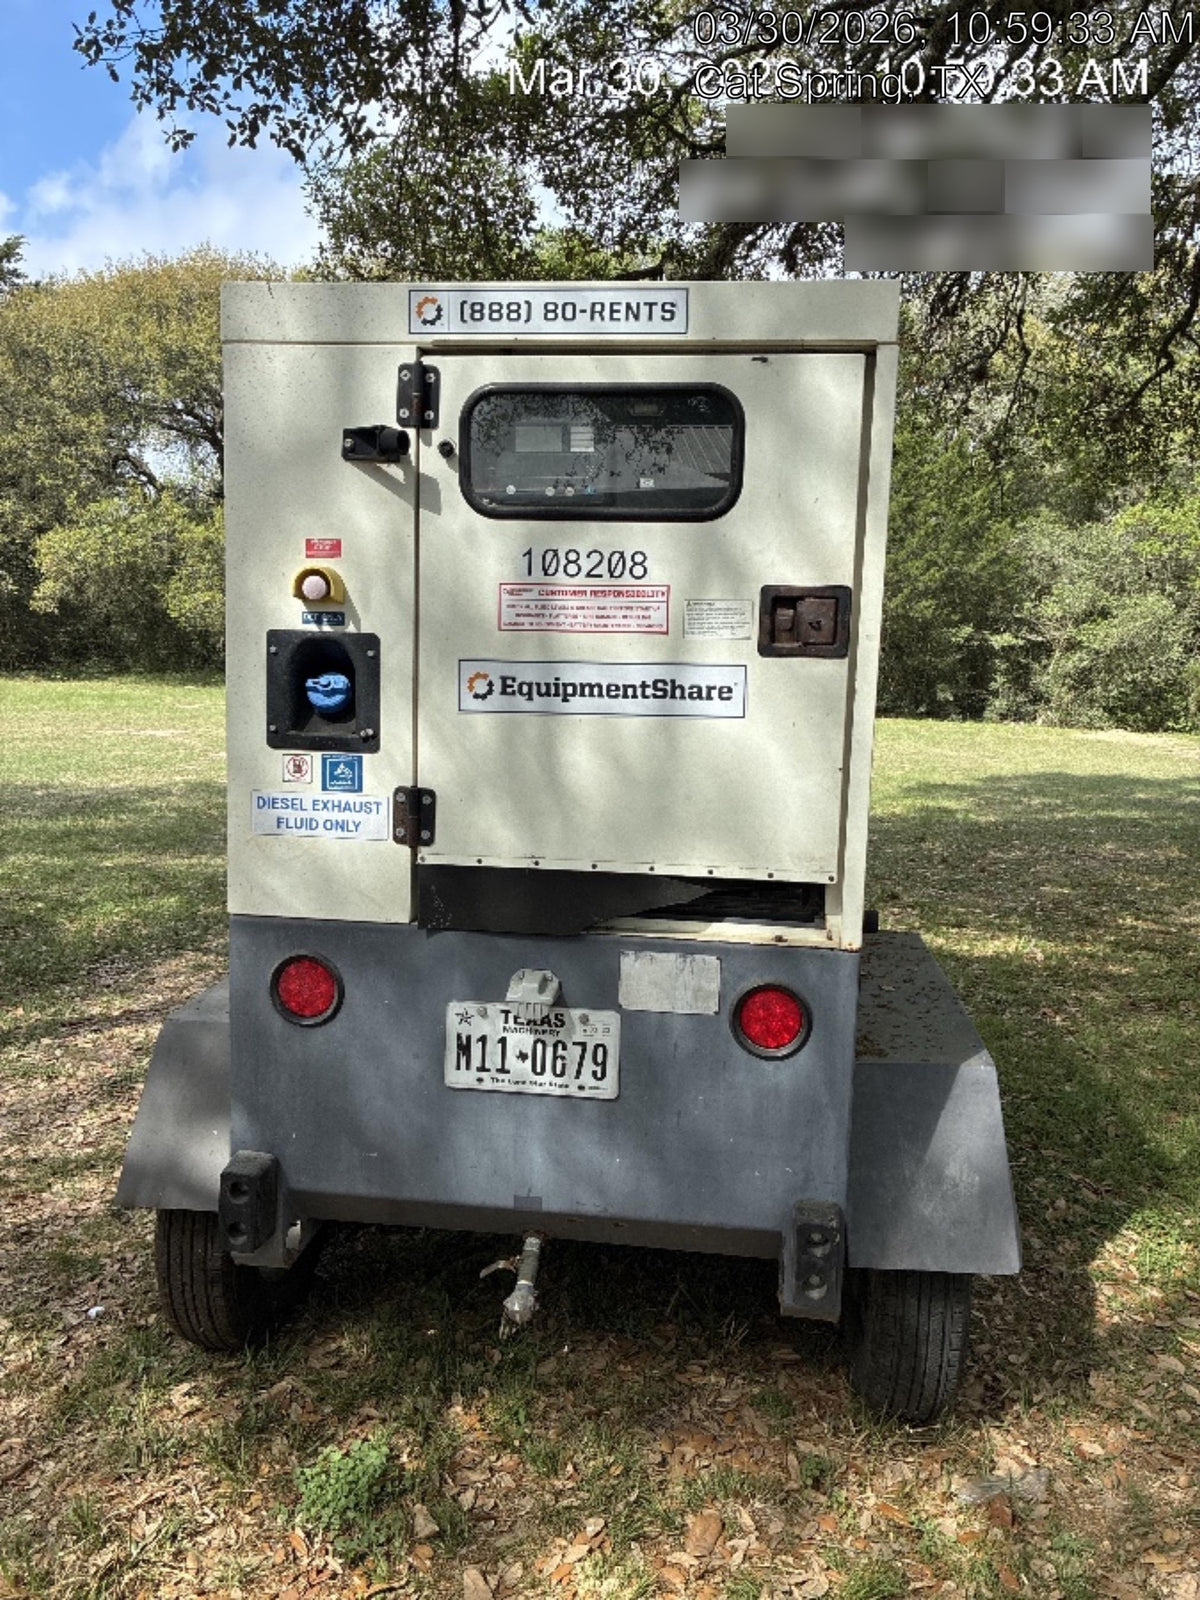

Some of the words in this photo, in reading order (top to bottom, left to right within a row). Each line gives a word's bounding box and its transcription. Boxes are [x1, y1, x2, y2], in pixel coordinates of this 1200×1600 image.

[460, 301, 532, 323] (888)
[543, 301, 678, 323] 80-RENTS
[521, 547, 649, 580] 108208
[499, 675, 734, 703] EquipmentShare
[256, 796, 308, 812] DIESEL
[312, 799, 383, 815] EXHAUST
[276, 816, 320, 831] FLUID
[322, 818, 362, 833] ONLY
